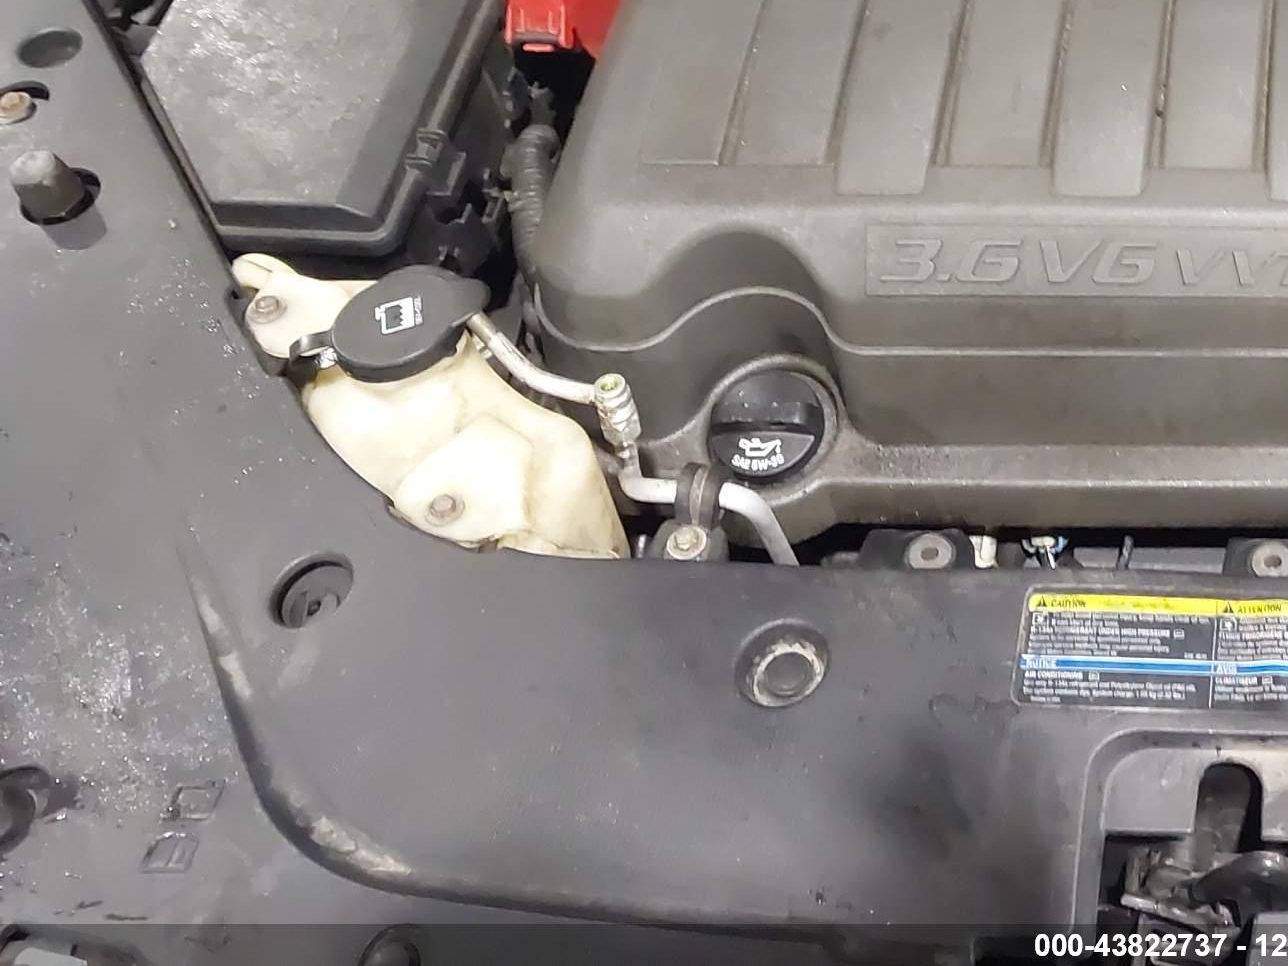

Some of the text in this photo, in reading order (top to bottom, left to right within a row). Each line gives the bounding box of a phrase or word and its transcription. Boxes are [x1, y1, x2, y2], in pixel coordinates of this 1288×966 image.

[880, 238, 1023, 284] 3.6
[1050, 599, 1087, 608] CAUTION
[1237, 604, 1282, 614] ATTENTION
[1025, 658, 1057, 669] NOTICE
